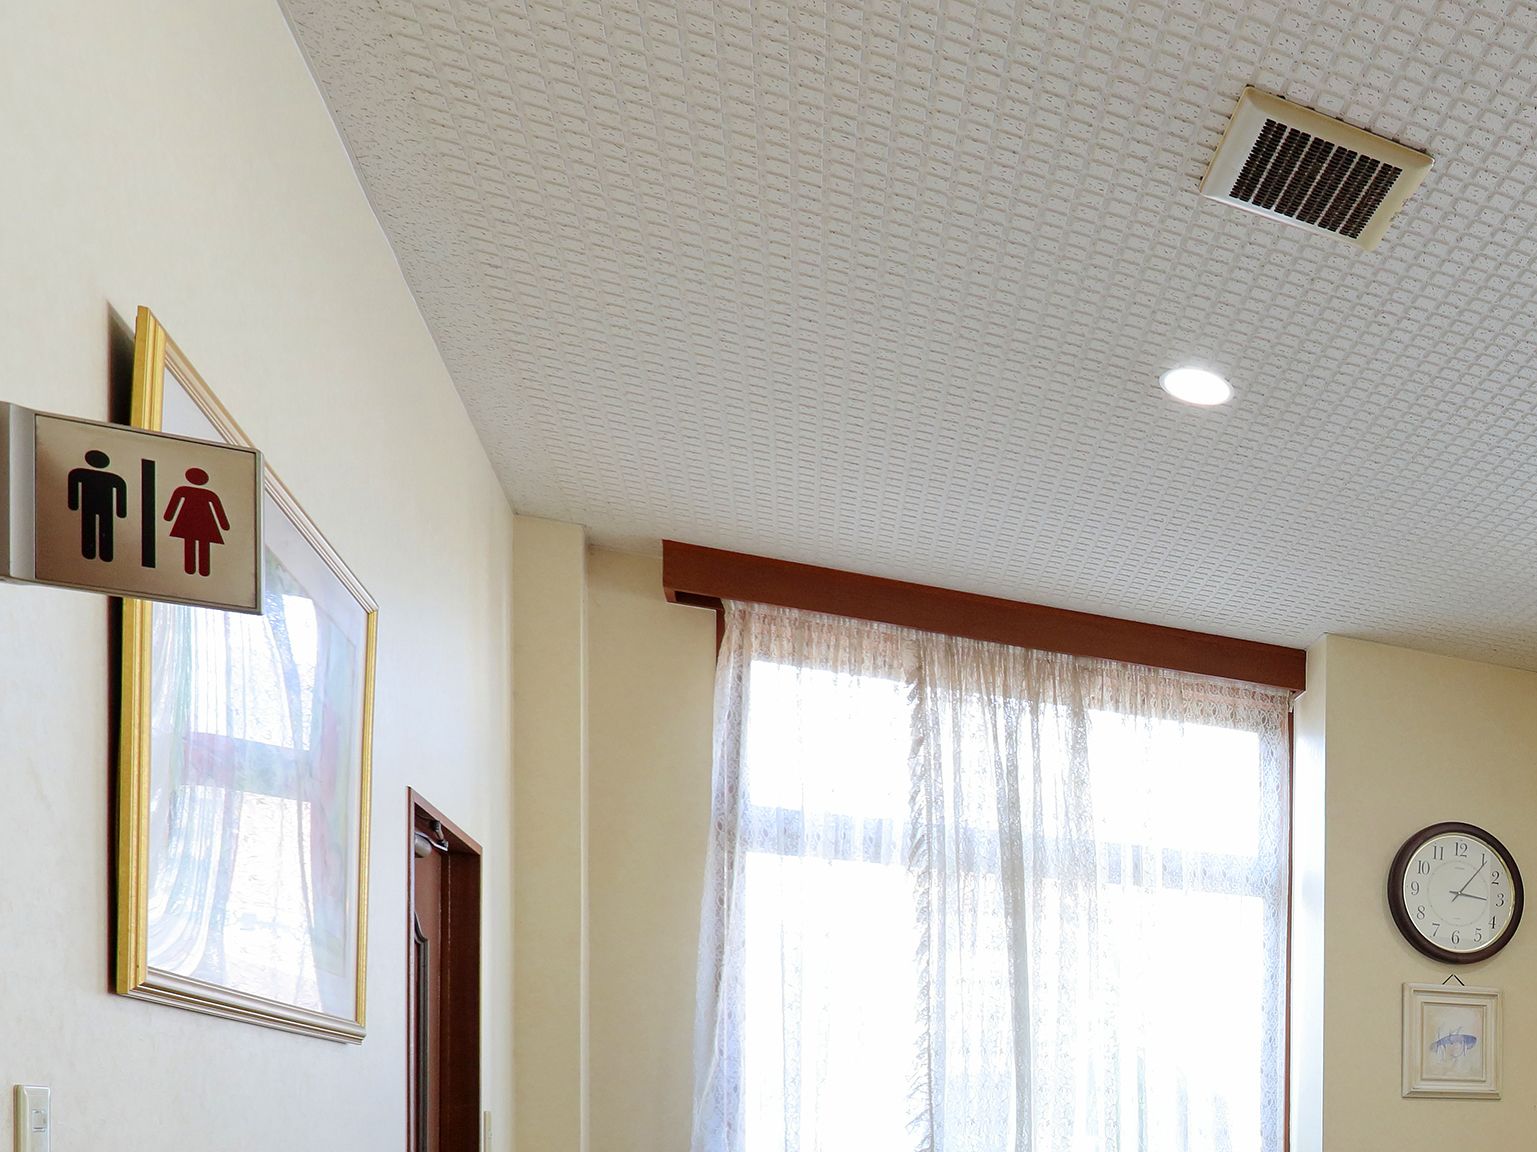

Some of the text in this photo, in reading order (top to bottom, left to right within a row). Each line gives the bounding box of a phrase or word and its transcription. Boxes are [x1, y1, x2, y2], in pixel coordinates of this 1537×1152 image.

[1433, 845, 1444, 861] 11
[1455, 842, 1468, 858] 12
[1417, 860, 1430, 875] 10
[1491, 870, 1500, 885] 2
[1410, 881, 1420, 896] 9
[1495, 893, 1504, 907] 3
[1416, 905, 1426, 921] 8
[1432, 922, 1440, 937] 7
[1488, 915, 1497, 929] 4
[1451, 930, 1460, 944] 6
[1474, 928, 1482, 942] 5
